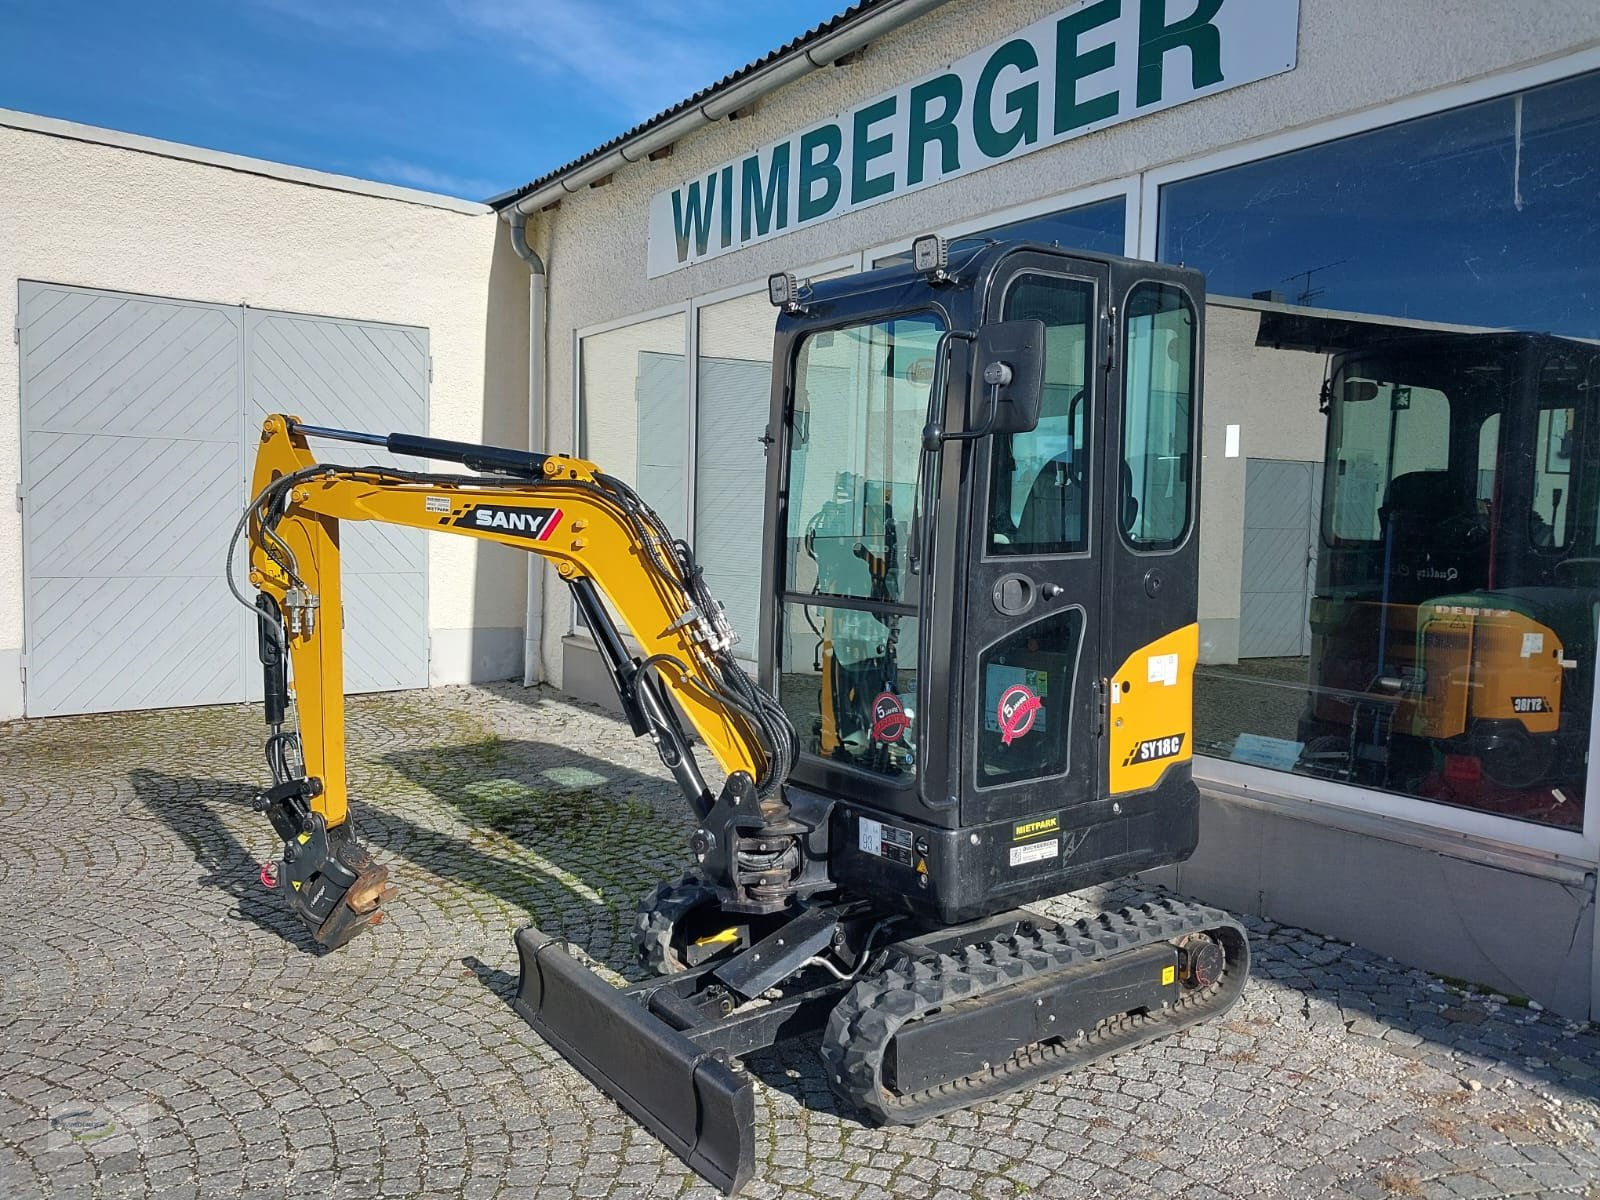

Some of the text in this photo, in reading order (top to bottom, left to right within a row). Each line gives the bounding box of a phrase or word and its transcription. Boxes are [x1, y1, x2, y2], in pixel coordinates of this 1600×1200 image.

[671, 0, 1225, 263] WIMBERGER
[476, 509, 544, 532] SANY
[877, 705, 885, 718] 5
[1003, 703, 1013, 718] 5
[1140, 736, 1180, 760] SY18C
[1015, 817, 1057, 835] MIETPARK
[863, 833, 873, 850] 93
